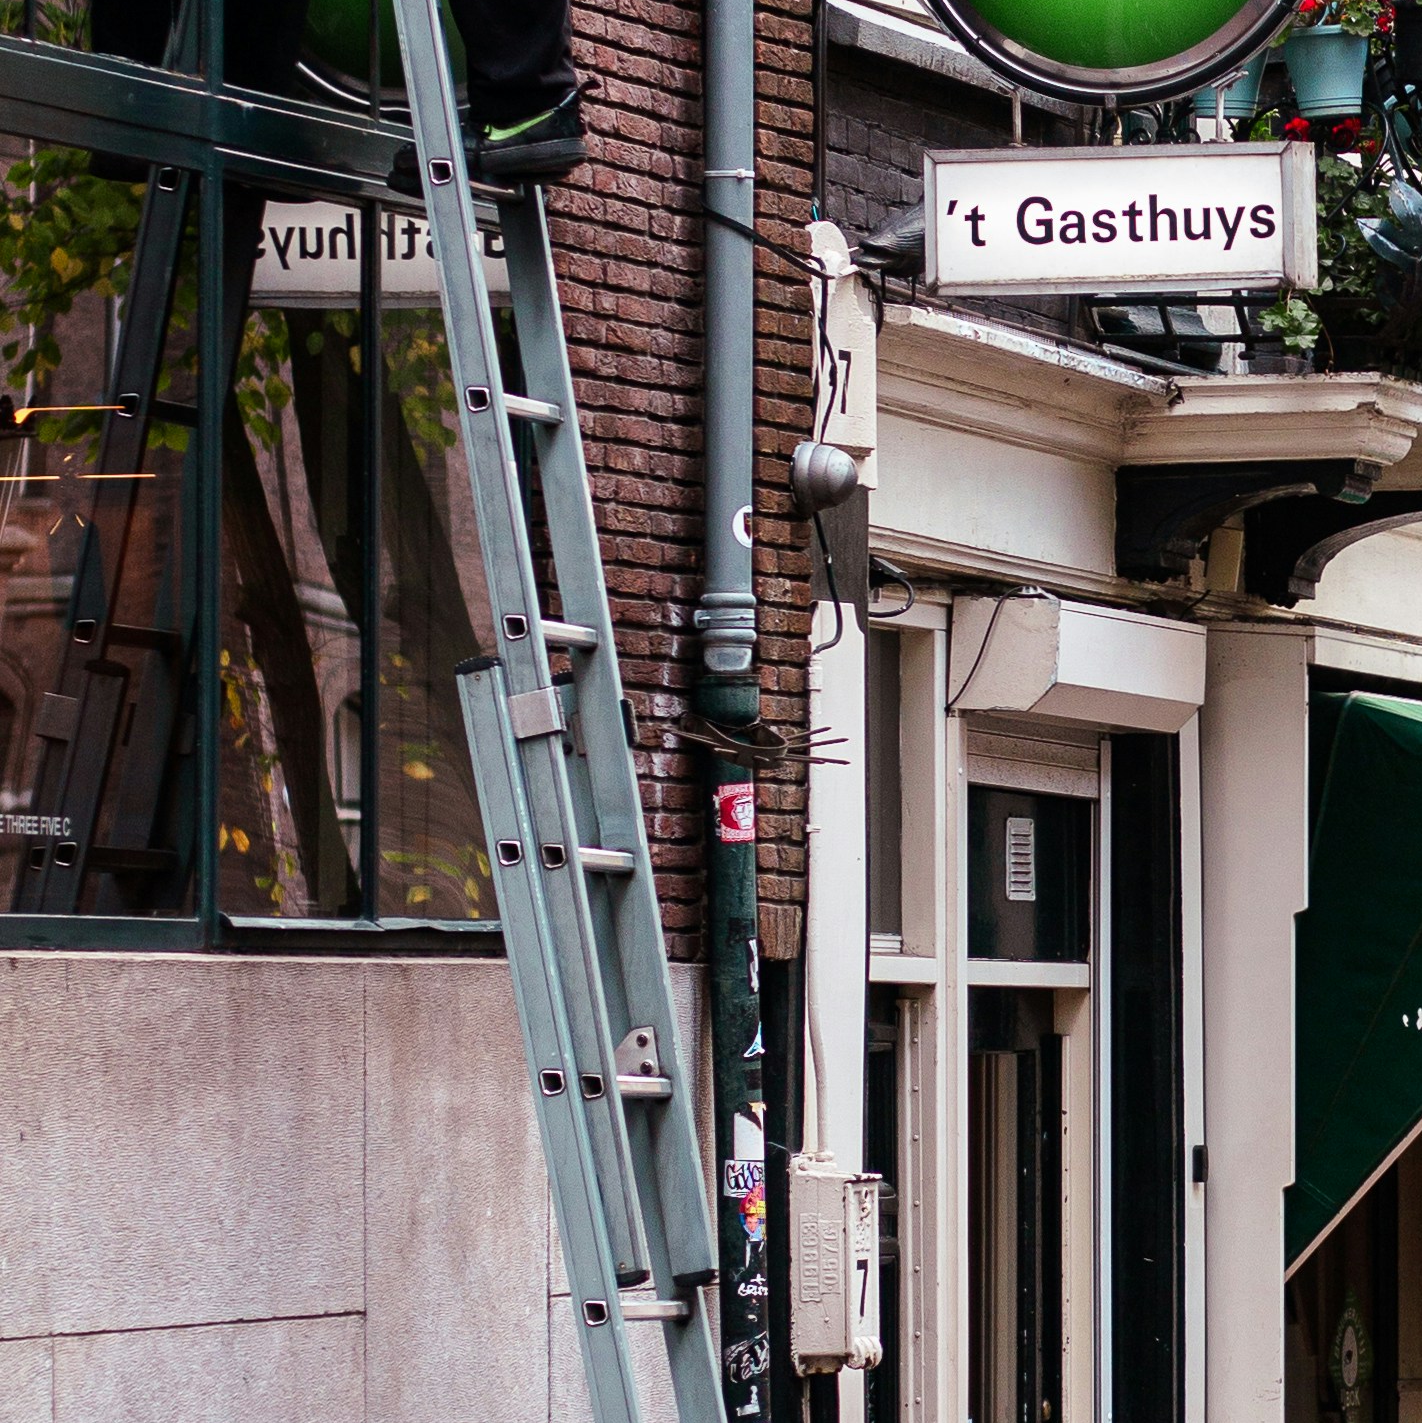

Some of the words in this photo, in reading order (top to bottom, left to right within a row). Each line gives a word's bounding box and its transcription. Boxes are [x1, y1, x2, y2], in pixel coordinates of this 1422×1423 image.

[1015, 193, 1277, 251] Gasthuys
[5, 814, 39, 835] THREE
[40, 816, 61, 836] FIVE
